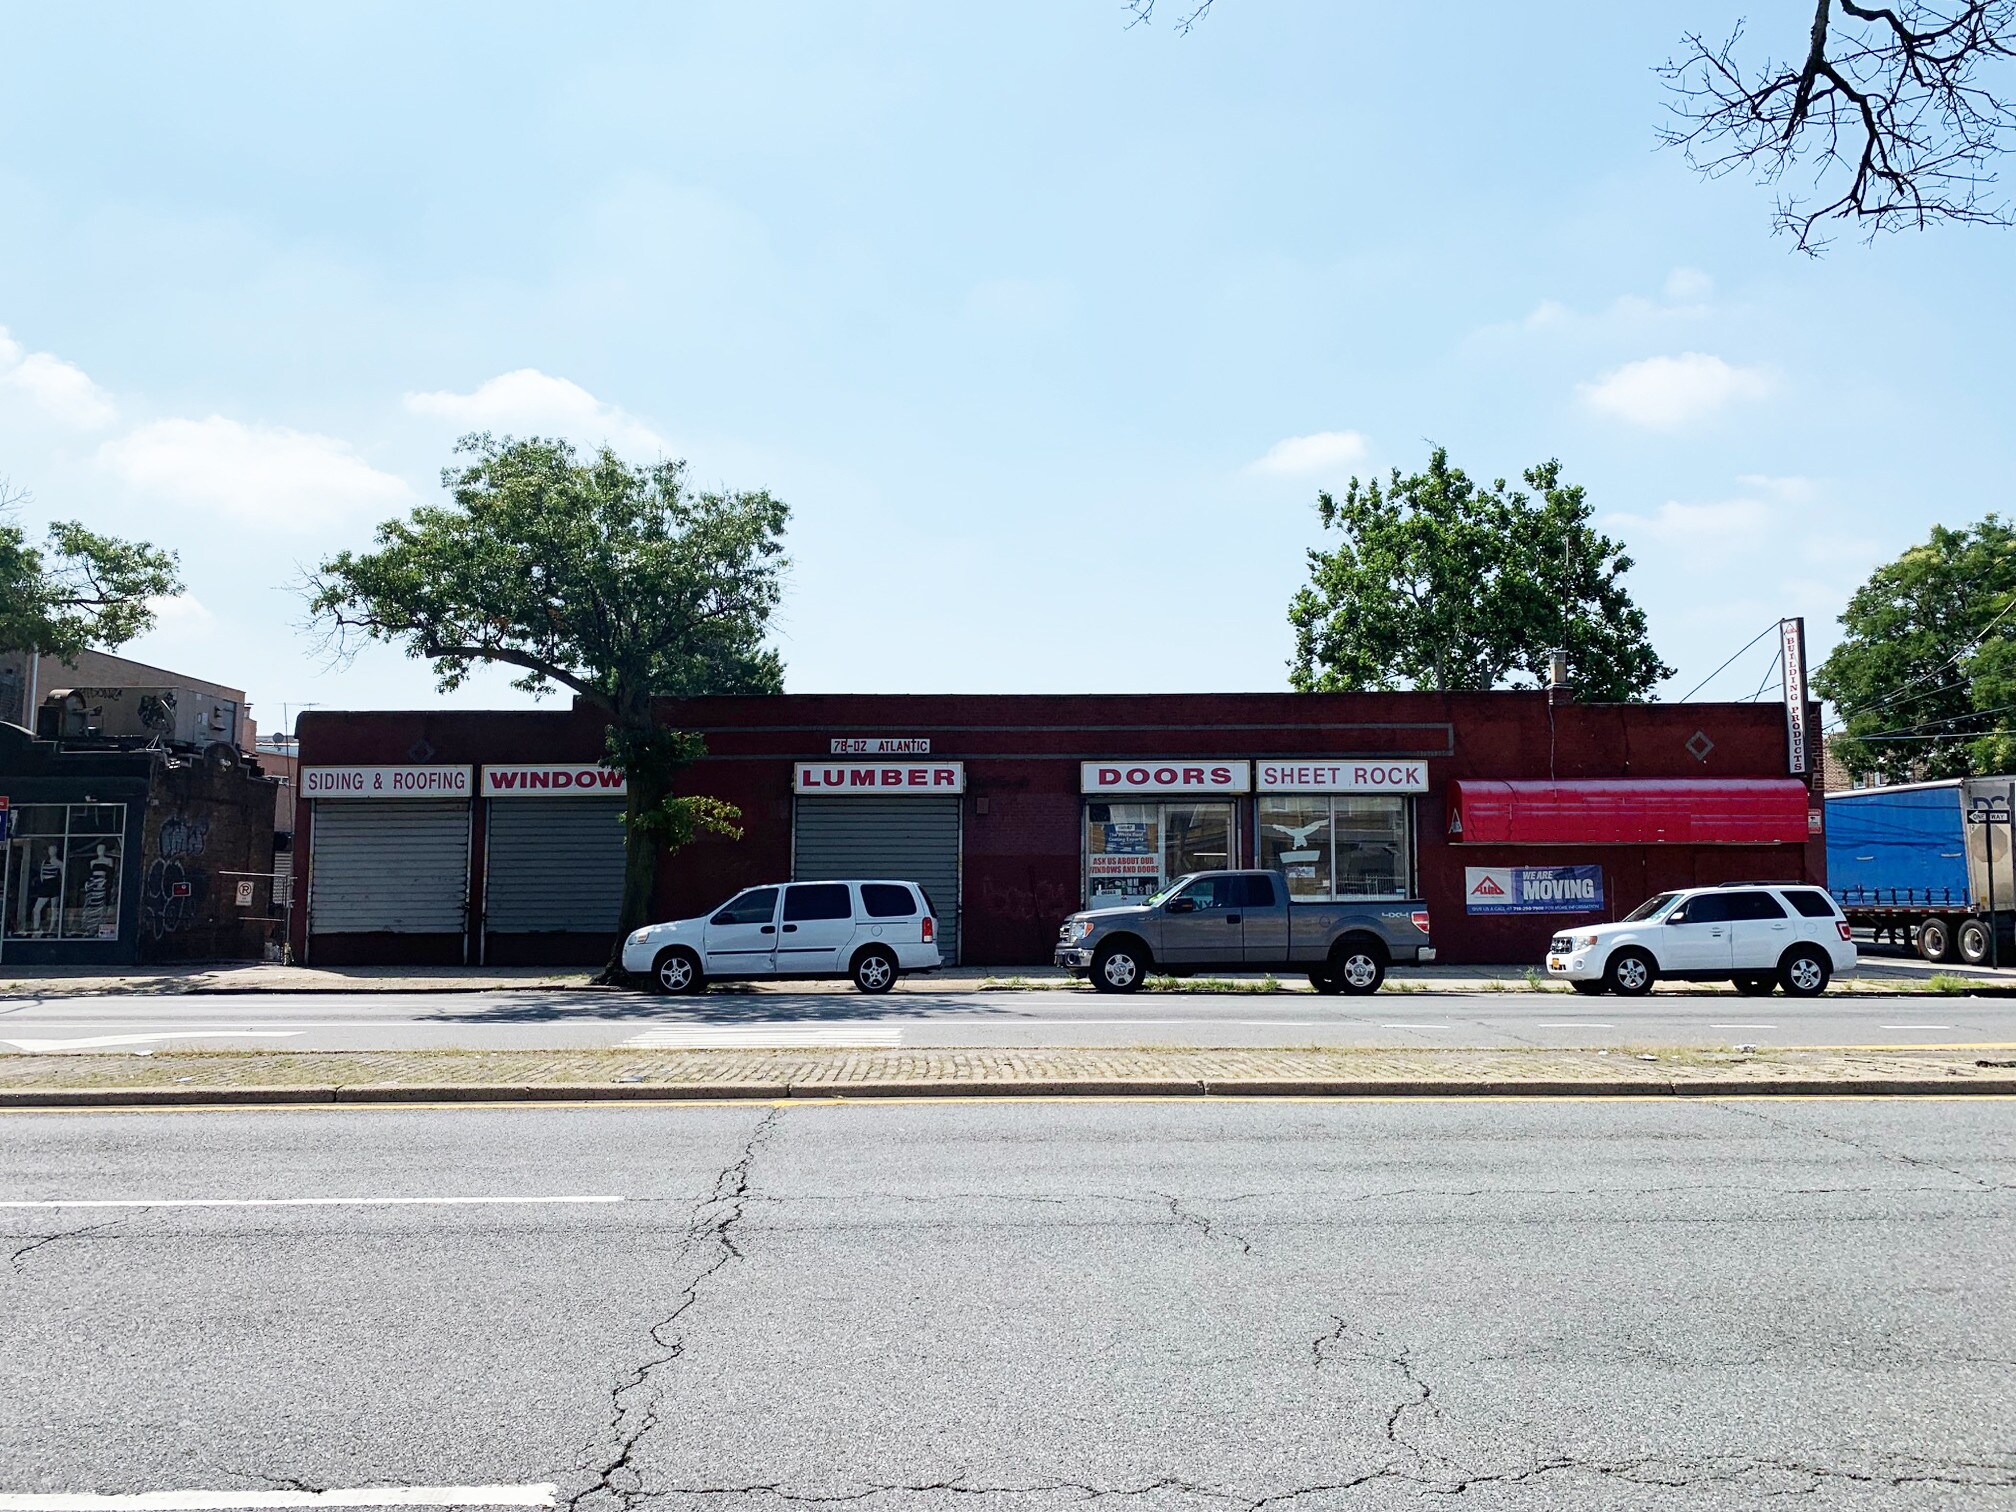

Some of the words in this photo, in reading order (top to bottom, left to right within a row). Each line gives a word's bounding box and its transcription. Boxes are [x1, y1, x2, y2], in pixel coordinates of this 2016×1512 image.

[1787, 637, 1798, 701] BUILDING
[878, 740, 928, 752] ATLANTIC
[1791, 706, 1802, 771] PRODUCTS
[308, 772, 364, 790] SIDING
[373, 772, 383, 790] &
[393, 771, 465, 790] ROOFING
[802, 769, 955, 787] LUMBER
[1098, 767, 1232, 786] DOORS
[1264, 767, 1341, 785] SHEET
[1354, 767, 1420, 785] ROCK
[1093, 857, 1107, 865] ASK
[1108, 857, 1116, 865] US
[1117, 857, 1140, 865] ABOUT
[1140, 857, 1155, 865] OUR
[1122, 865, 1137, 873] AND
[1137, 865, 1159, 873] DOORS
[1523, 871, 1536, 880] WE
[1536, 870, 1553, 880] ARE
[1523, 879, 1595, 900] MOVING
